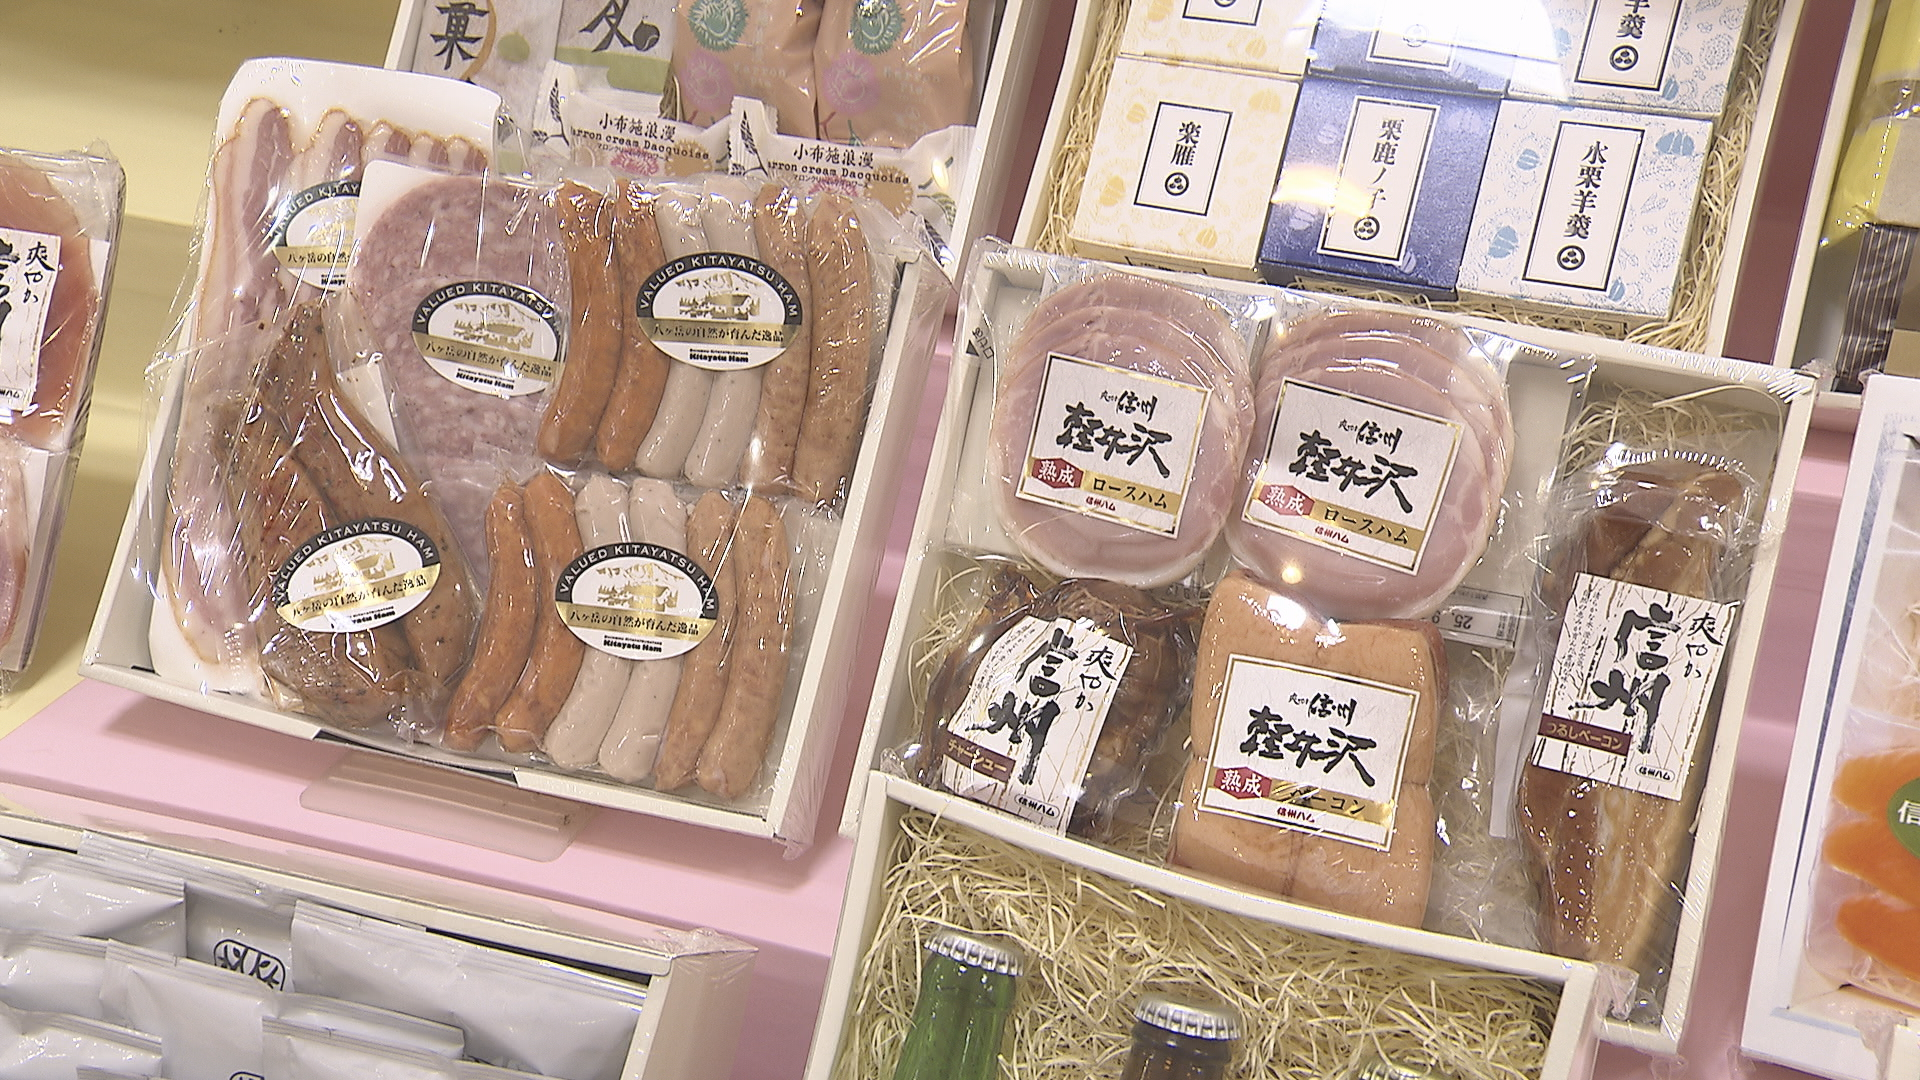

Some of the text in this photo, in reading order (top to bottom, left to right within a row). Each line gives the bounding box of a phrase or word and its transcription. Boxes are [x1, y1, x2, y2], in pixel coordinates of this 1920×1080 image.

[600, 112, 676, 143] 小布施浪漫
[644, 140, 709, 160] Dacquoise
[1170, 121, 1201, 166] 楽雁
[793, 143, 874, 169] 小布施浪漫
[842, 168, 909, 185] Dacquoise
[1367, 119, 1405, 210] 栗鹿ノ子
[1563, 140, 1609, 239] 水栗羊羹
[24, 242, 56, 304] 爽やか
[640, 255, 797, 317] VALUED KITAYATSU HAM
[417, 282, 554, 324] VALUED KITAYATSU
[653, 323, 784, 343] 八ヶ岳の自然が育んだ逸品
[1056, 401, 1173, 479] 軽井沢
[1037, 459, 1168, 510] 熟成 ロースハム
[1288, 430, 1418, 514] 軽井沢
[1086, 496, 1116, 511] 信州ハム
[1265, 486, 1409, 545] 熟成 ロースハム
[1314, 526, 1350, 544] 信州ハム
[276, 521, 434, 601] VALUED KITAYATSU HAM
[560, 545, 715, 611] VALUED KITAYATSU HAM
[570, 611, 699, 636] 八ヶ岳の自然が育んだ逸品
[1684, 612, 1723, 679] 爽やか
[1074, 645, 1117, 712] 爽やか
[1568, 603, 1681, 754] 信州
[965, 627, 1078, 786] 信州
[947, 739, 1007, 773] チャーシュー
[1239, 705, 1377, 788] 軽井沢
[1546, 722, 1623, 751] つるしベーコン
[1220, 769, 1263, 798] 熟成
[1638, 764, 1671, 781] 信州ハム
[1018, 797, 1055, 817] 信州ハム
[1277, 806, 1315, 823] 信州ハム
